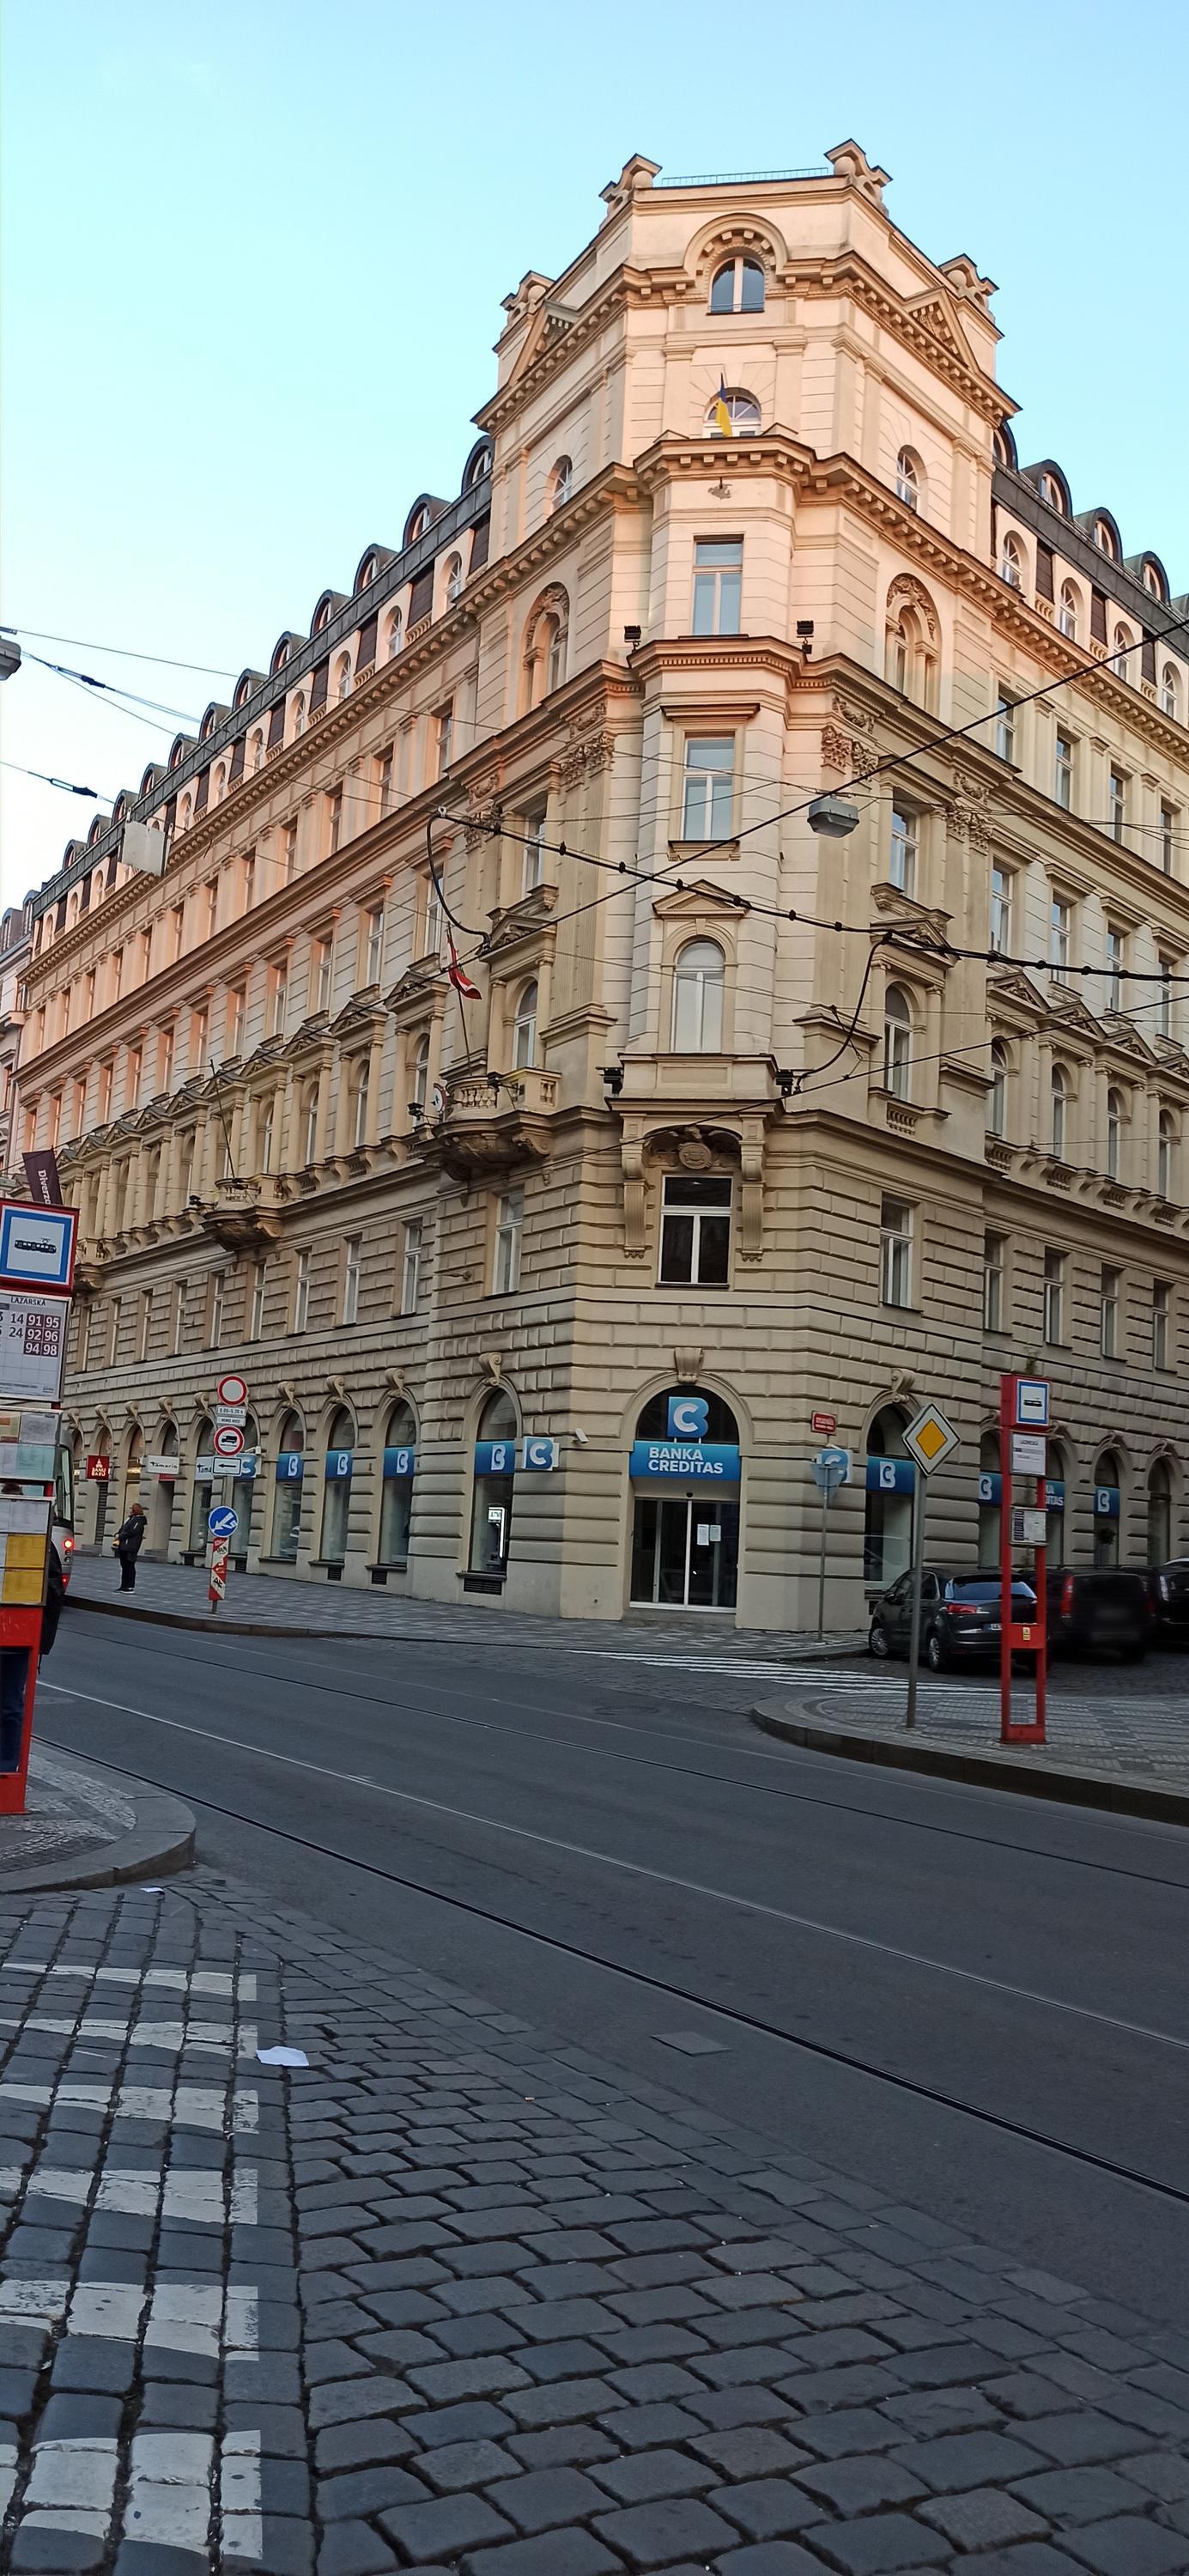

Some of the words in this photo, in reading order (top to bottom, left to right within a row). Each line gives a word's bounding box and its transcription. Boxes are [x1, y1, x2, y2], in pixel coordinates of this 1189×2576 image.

[10, 1313, 24, 1325] 14
[27, 1314, 42, 1327] 91
[45, 1316, 59, 1328] 95
[9, 1327, 23, 1339] 24
[27, 1328, 42, 1340] 92
[44, 1330, 58, 1342] 96
[25, 1342, 39, 1354] 94
[43, 1344, 58, 1356] 98
[649, 1447, 703, 1461] BANKA
[648, 1460, 724, 1474] CREDITAS
